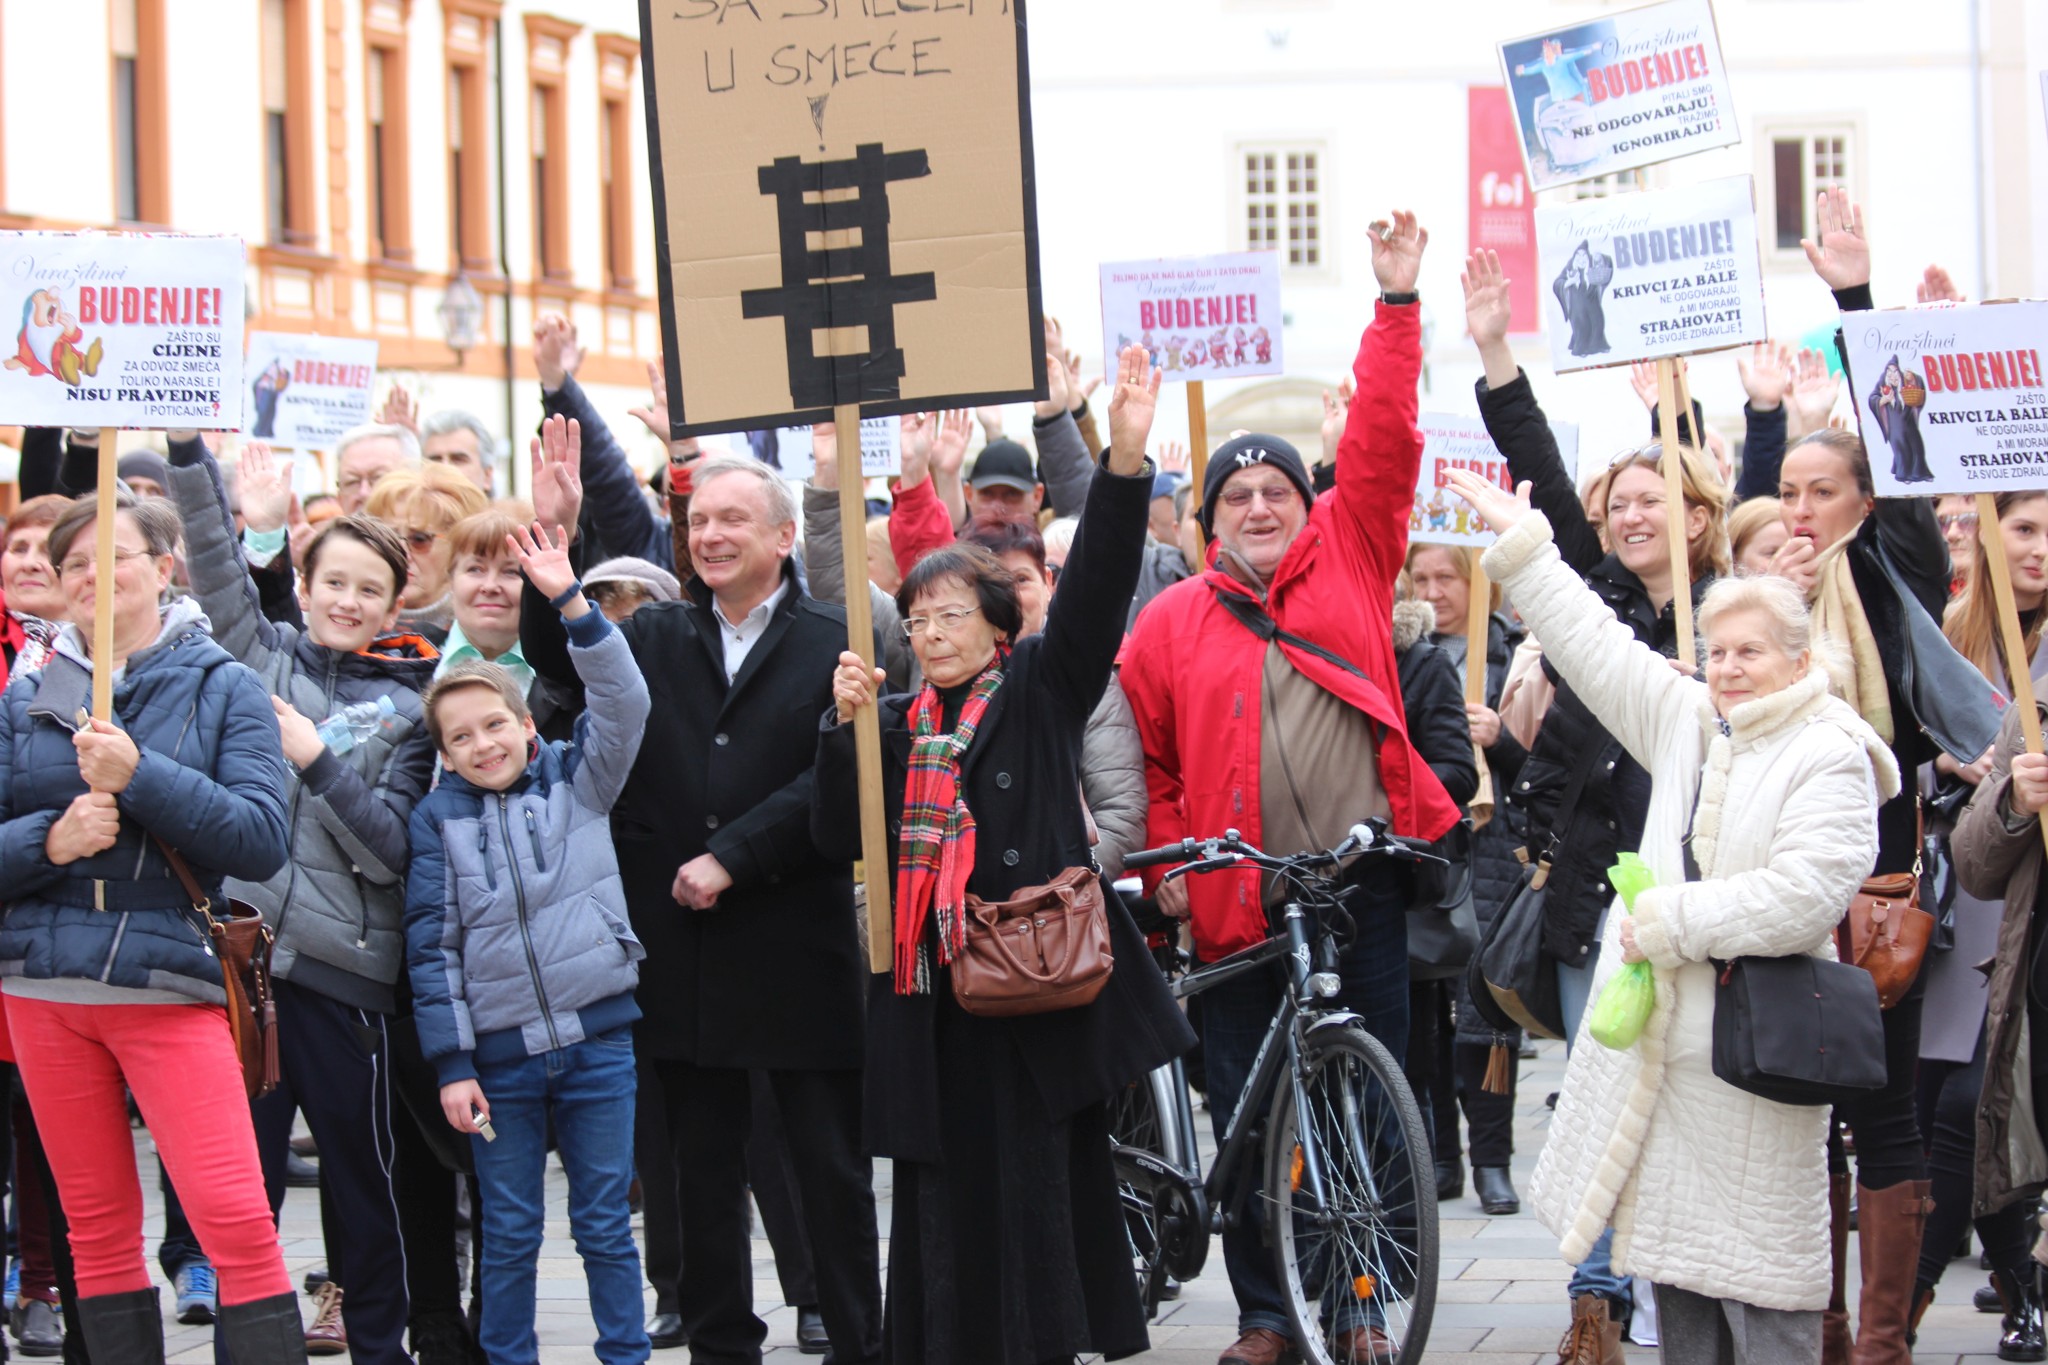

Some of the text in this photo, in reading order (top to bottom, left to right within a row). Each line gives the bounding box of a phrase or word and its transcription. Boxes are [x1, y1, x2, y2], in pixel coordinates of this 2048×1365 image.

[705, 30, 951, 93] U SMEĆE
[1662, 84, 1712, 102] PITALI SMO
[1678, 108, 1718, 125] TRAŽIMO
[1572, 124, 1595, 139] NE
[1704, 258, 1734, 271] ZAŠTO
[1613, 270, 1738, 299] KRIVCI ZA BALE
[79, 286, 222, 326] BUĐENJE!
[1660, 294, 1672, 304] NE
[1679, 297, 1741, 314] A MI MORAMO
[1640, 309, 1741, 334] STRAHOVATI
[167, 330, 221, 343] ZAŠTO SU
[1645, 336, 1657, 346] ZA
[1660, 330, 1688, 344] SVOJE
[153, 344, 221, 358] CIJENE
[124, 359, 220, 372] ZA ODVOZ SMEĆA
[1922, 349, 2043, 393] BUĐENJE!
[120, 375, 160, 387] TOLIKO
[163, 376, 214, 387] NARASLE
[67, 388, 221, 403] NISU PRAVEDNE
[2016, 392, 2046, 405] ZAŠTO
[1928, 410, 1982, 424] KRIVCI
[1985, 409, 2007, 422] ZA
[1976, 426, 1989, 436] NE
[1997, 440, 2004, 449] A
[2005, 439, 2015, 449] MI
[1967, 470, 1979, 480] ZA
[1980, 469, 2009, 479] SVOJE
